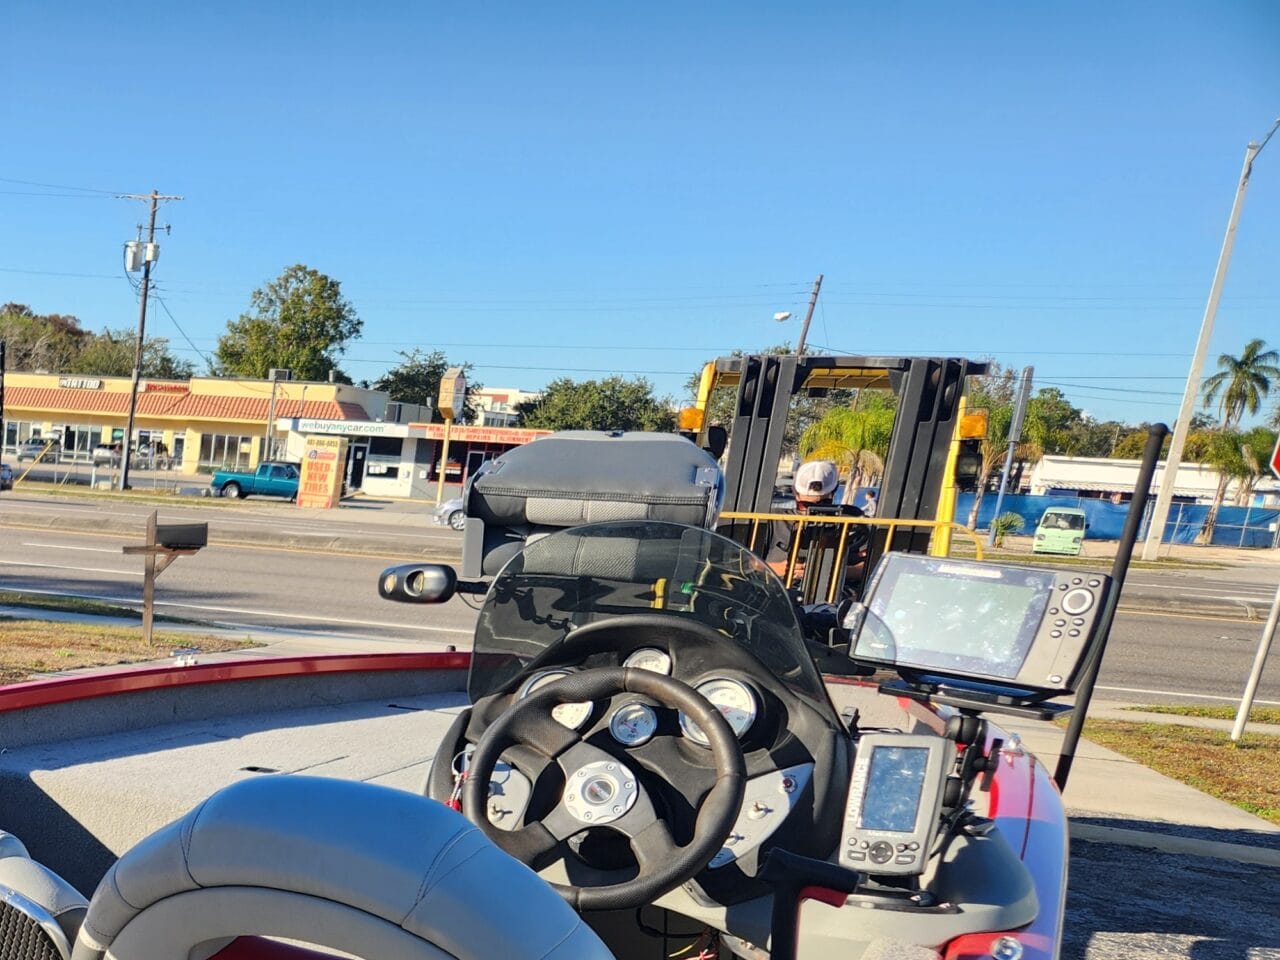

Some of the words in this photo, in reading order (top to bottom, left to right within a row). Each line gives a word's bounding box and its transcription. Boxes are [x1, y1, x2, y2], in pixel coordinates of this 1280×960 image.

[302, 421, 384, 433] webuyanycar.com
[307, 472, 328, 482] NEW
[304, 482, 329, 493] TIRES
[847, 757, 870, 822] LOWRANCE
